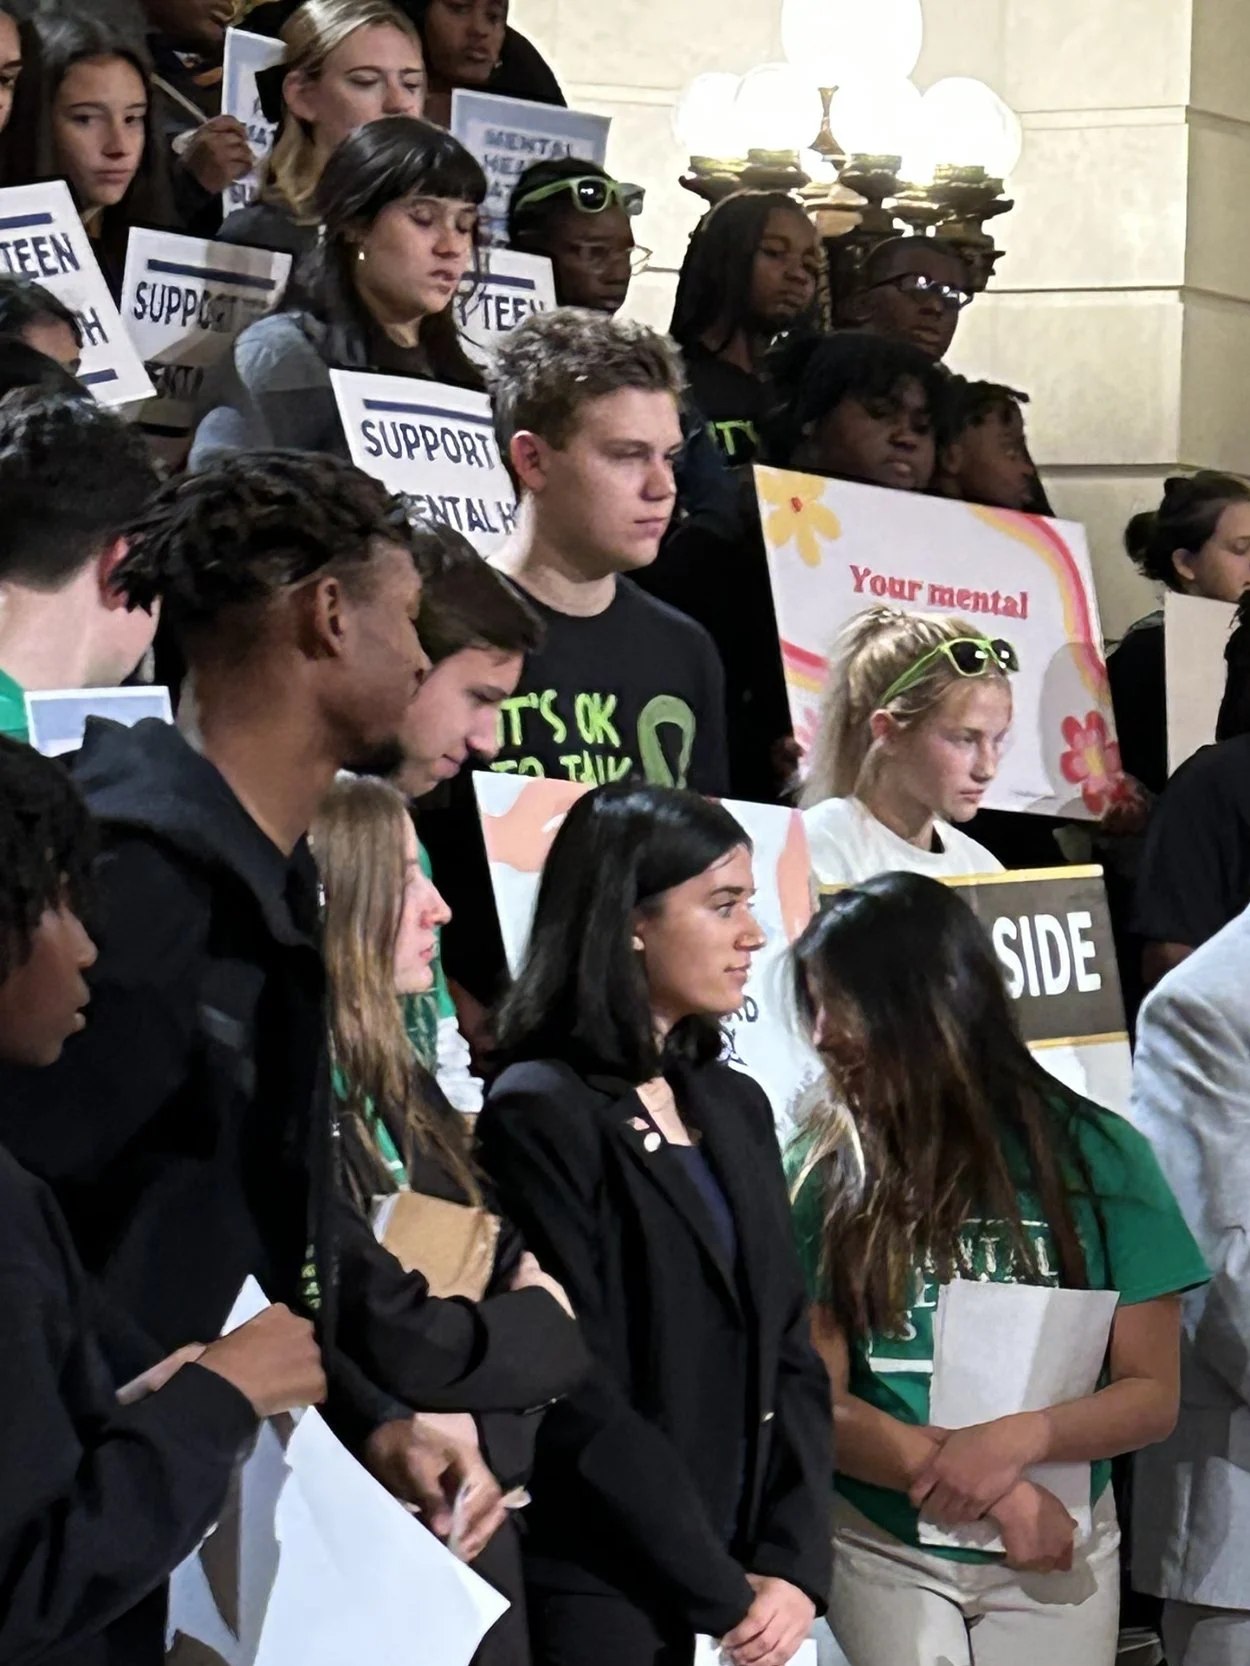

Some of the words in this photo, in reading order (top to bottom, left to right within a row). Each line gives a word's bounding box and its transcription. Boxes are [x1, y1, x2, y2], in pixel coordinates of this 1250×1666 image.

[361, 419, 495, 470] SUPPORT
[849, 564, 924, 602] Your
[927, 582, 1029, 620] mental
[496, 688, 568, 747] IT'S
[574, 692, 621, 748] OK
